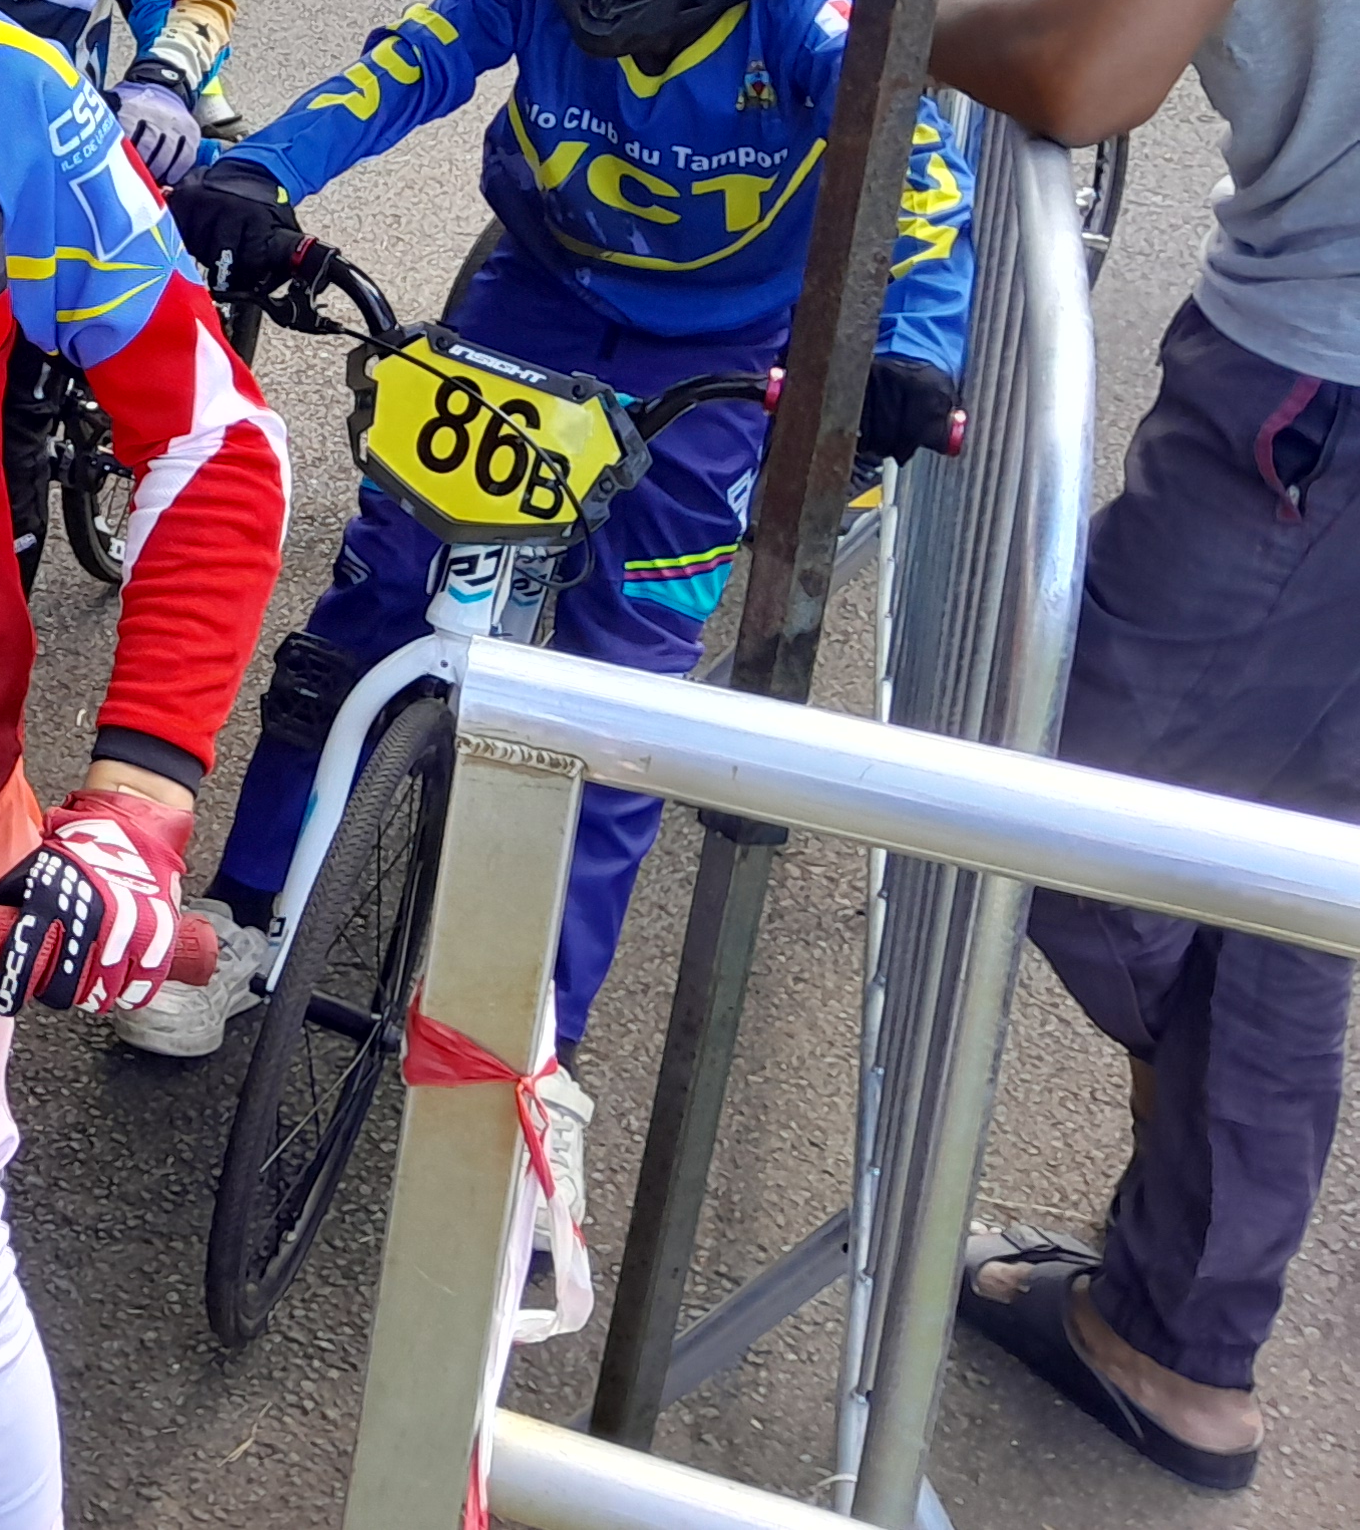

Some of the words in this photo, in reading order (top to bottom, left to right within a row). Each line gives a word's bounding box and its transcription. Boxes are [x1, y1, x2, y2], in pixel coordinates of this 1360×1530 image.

[47, 78, 107, 158] CSS
[562, 105, 620, 152] Club
[623, 138, 662, 168] du
[671, 140, 788, 178] Tampon
[448, 343, 548, 384] INSIGHT
[415, 375, 572, 521] 86B
